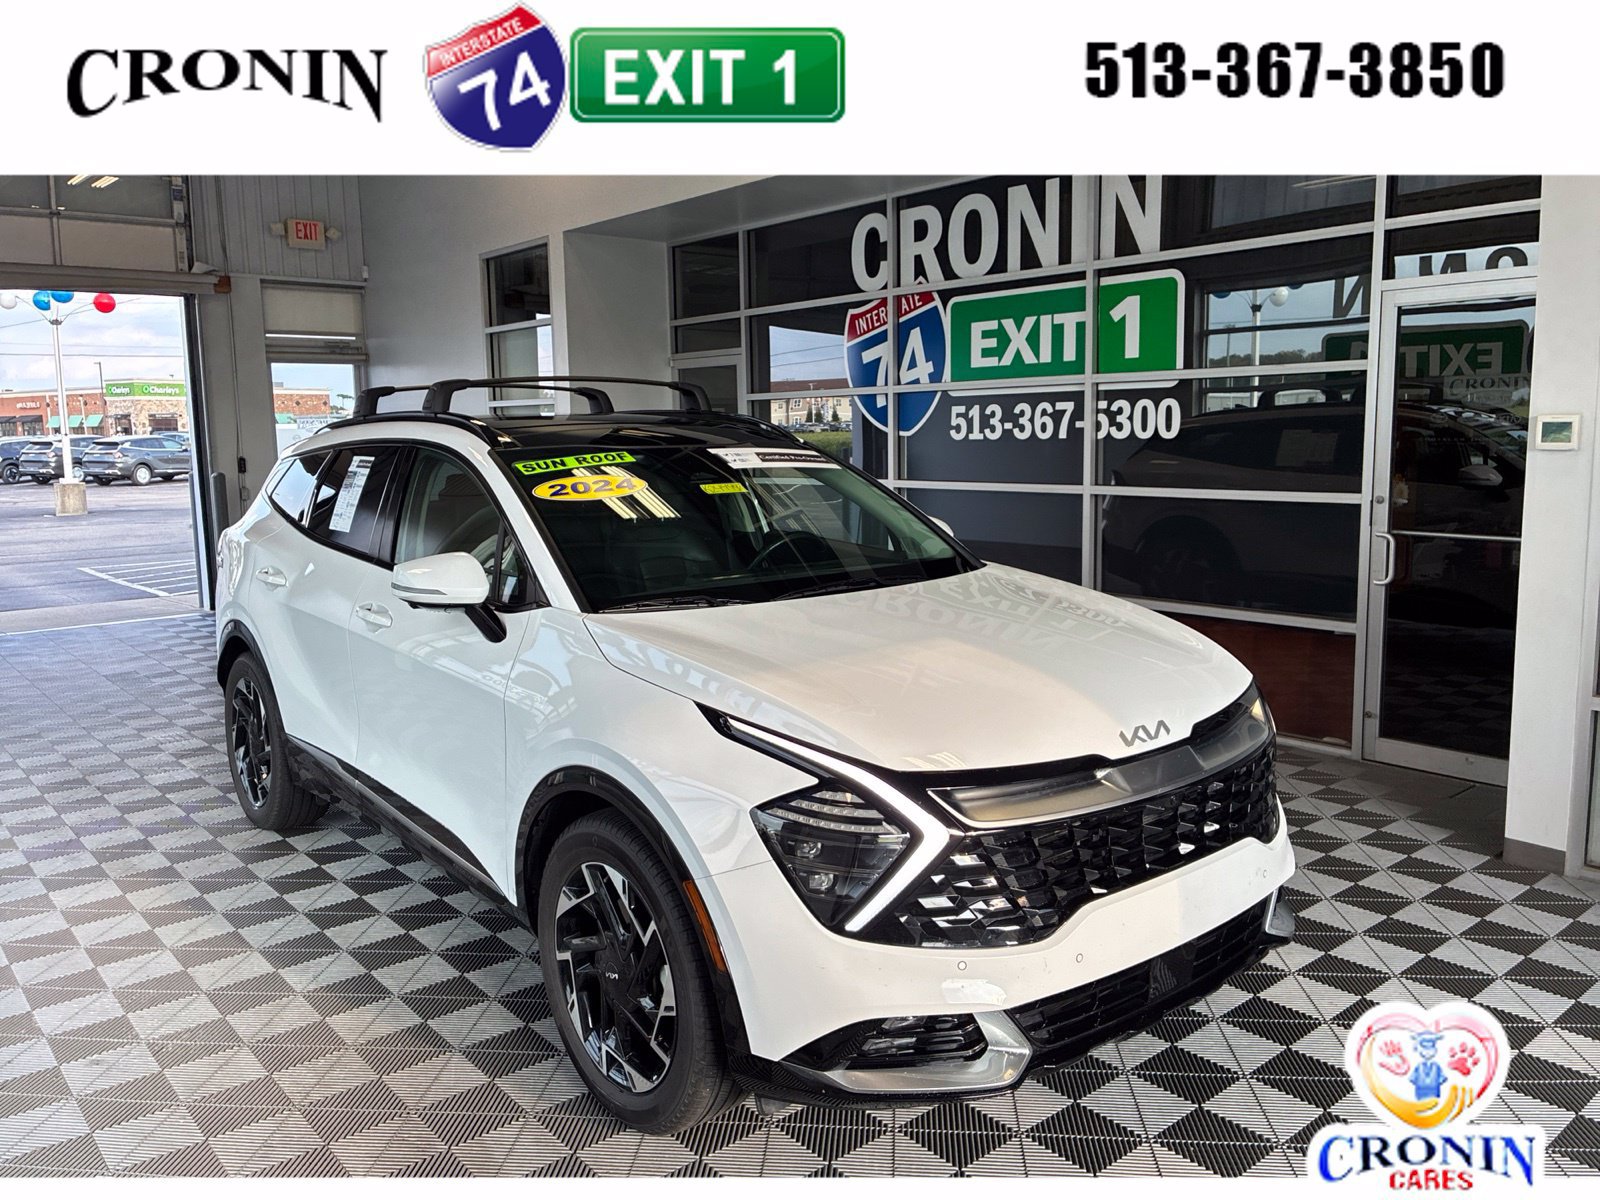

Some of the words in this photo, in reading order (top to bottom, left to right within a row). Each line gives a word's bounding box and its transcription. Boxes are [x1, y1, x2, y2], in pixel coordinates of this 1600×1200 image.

[295, 221, 319, 241] EXIT
[851, 175, 1162, 292] CRONIN
[854, 293, 923, 335] INTERATE
[970, 311, 1087, 368] EXIT
[1109, 295, 1141, 359] 1
[861, 326, 934, 409] 74
[950, 398, 1182, 441] 513-367-5300
[521, 460, 566, 473] SUN
[574, 452, 629, 466] ROOF
[547, 478, 637, 497] 2024
[1119, 719, 1171, 747] KIA
